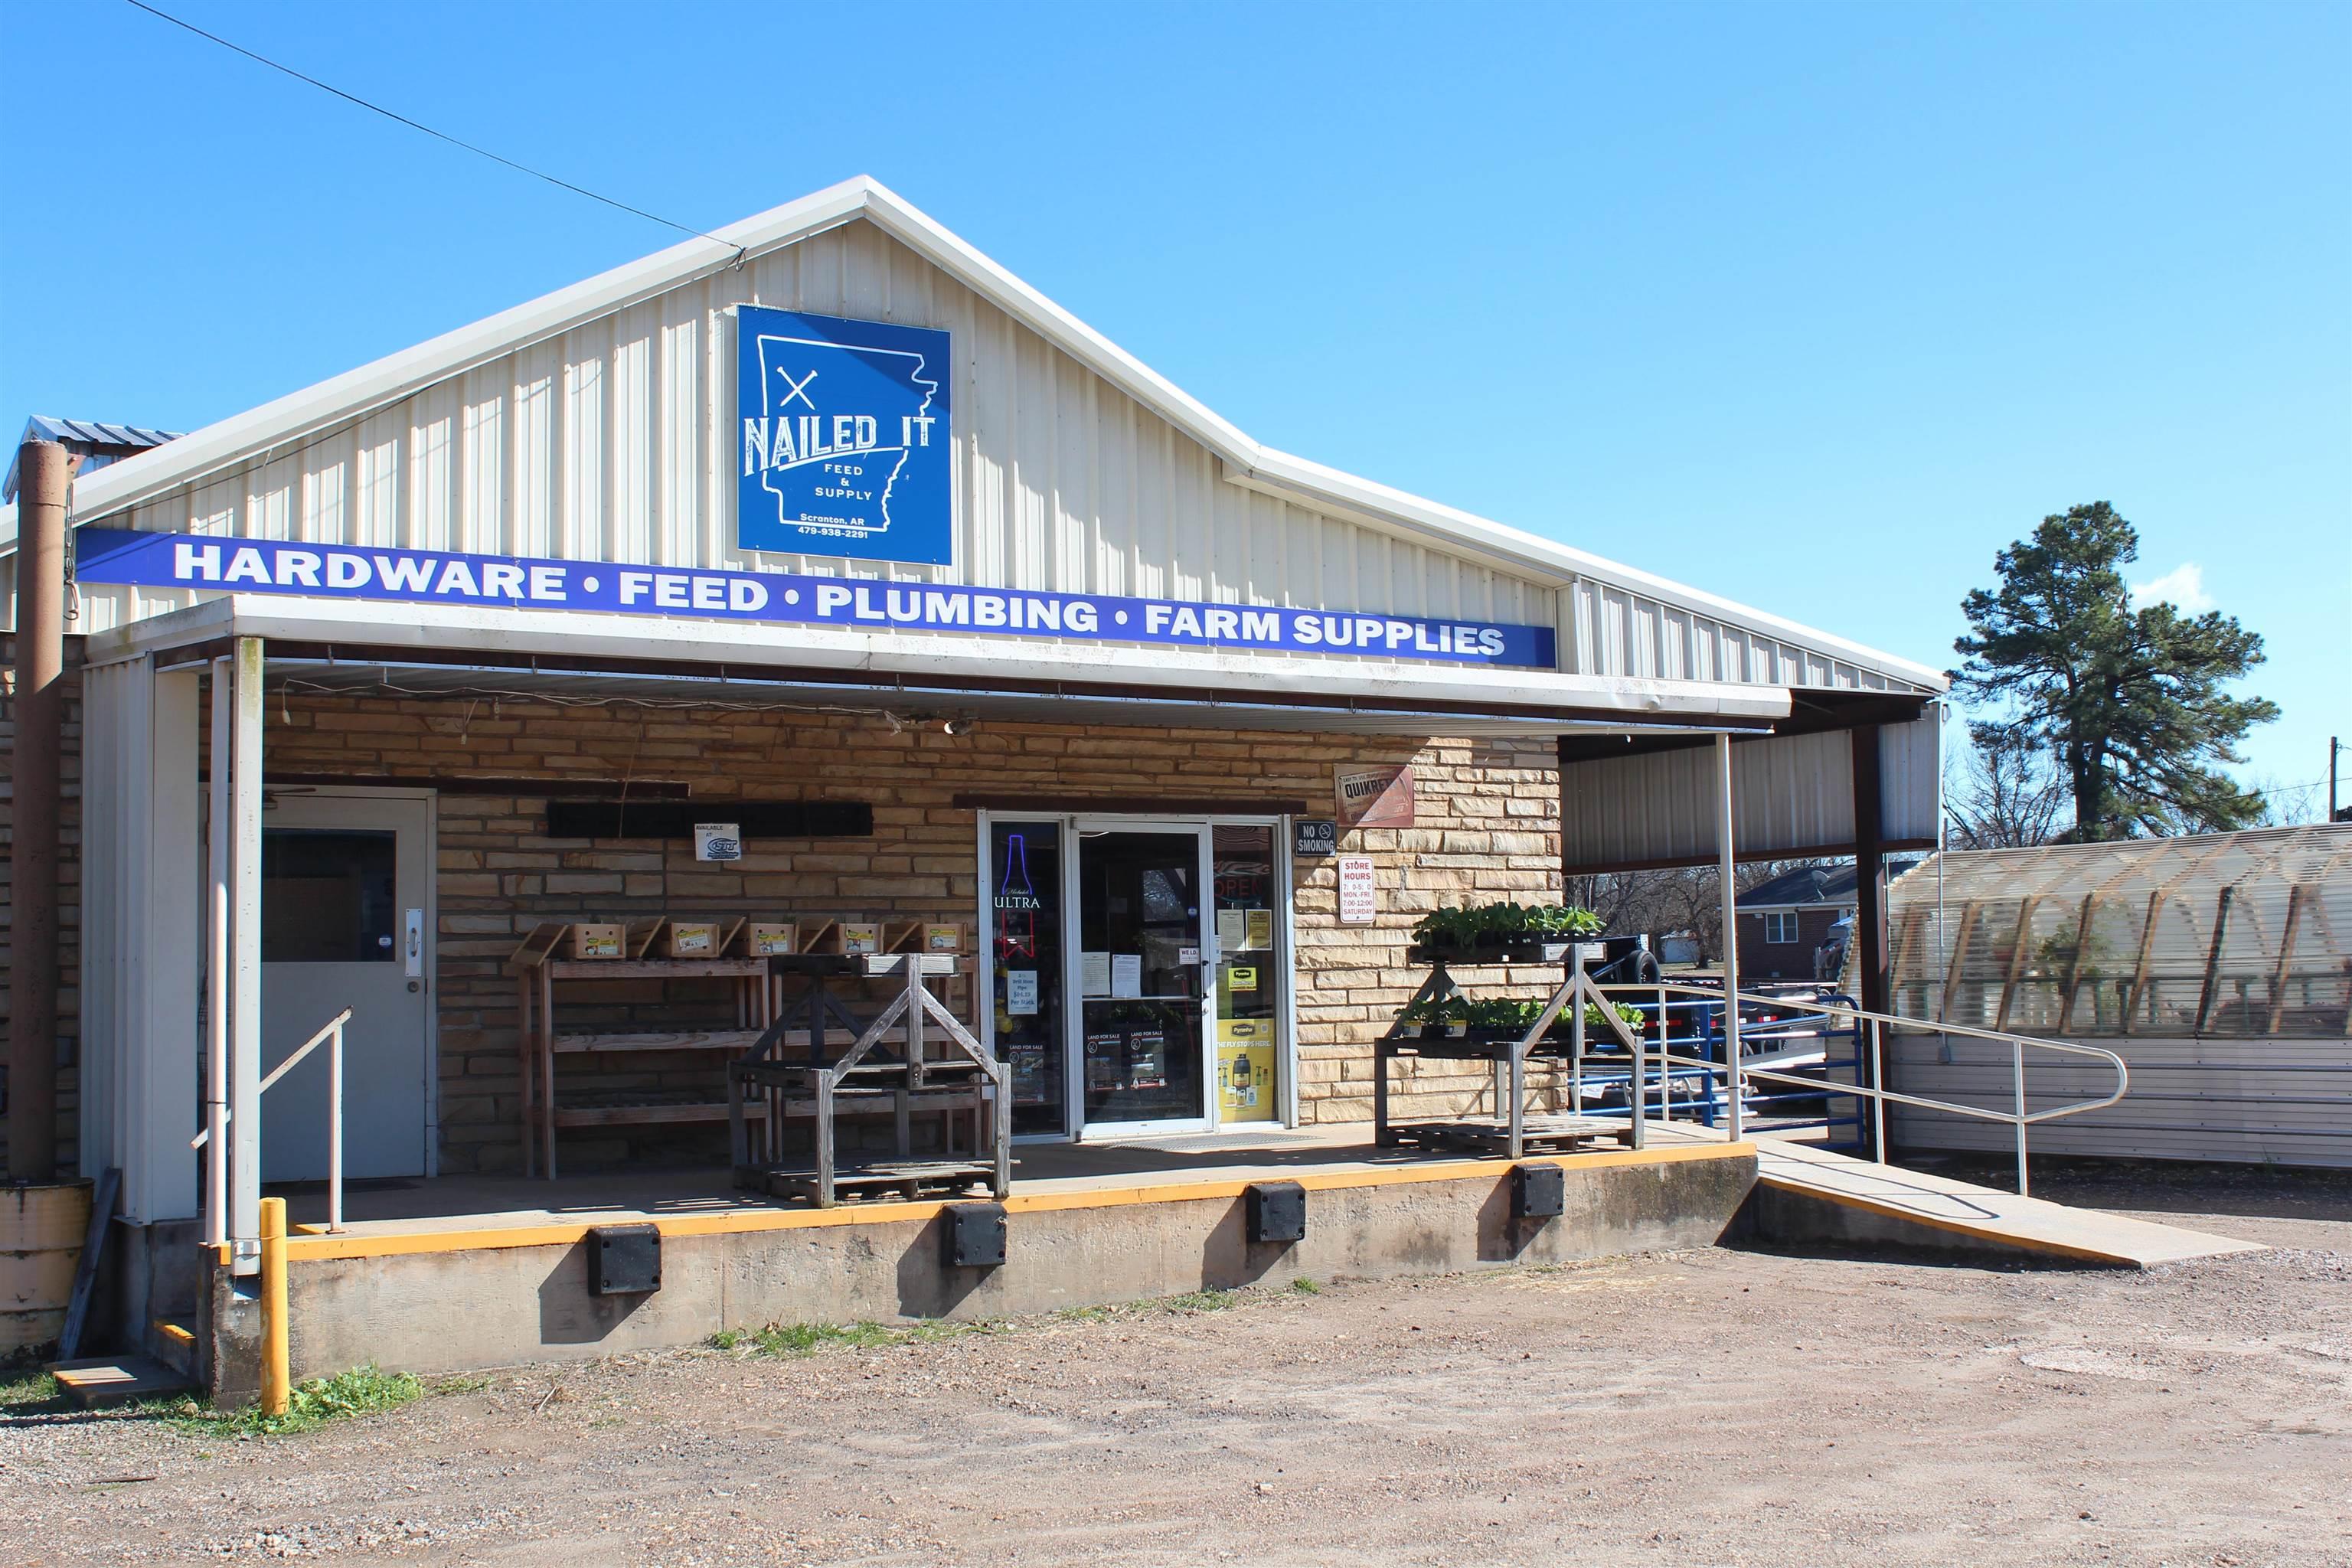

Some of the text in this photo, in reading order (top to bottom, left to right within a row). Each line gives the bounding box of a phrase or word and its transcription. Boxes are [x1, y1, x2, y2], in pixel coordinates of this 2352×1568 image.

[744, 415, 936, 477] NAILED IT
[825, 463, 863, 476] FEED
[840, 477, 851, 487] &
[815, 487, 872, 501] SUPPLY
[850, 517, 865, 527] AR
[797, 526, 868, 539] 479-938-2291
[174, 543, 1505, 656] HARDWARE FEED PLUMBING FARM SUPPLIES
[1303, 825, 1315, 838] NO
[1298, 839, 1334, 851] SMOKING
[995, 897, 1040, 908] ULTRA
